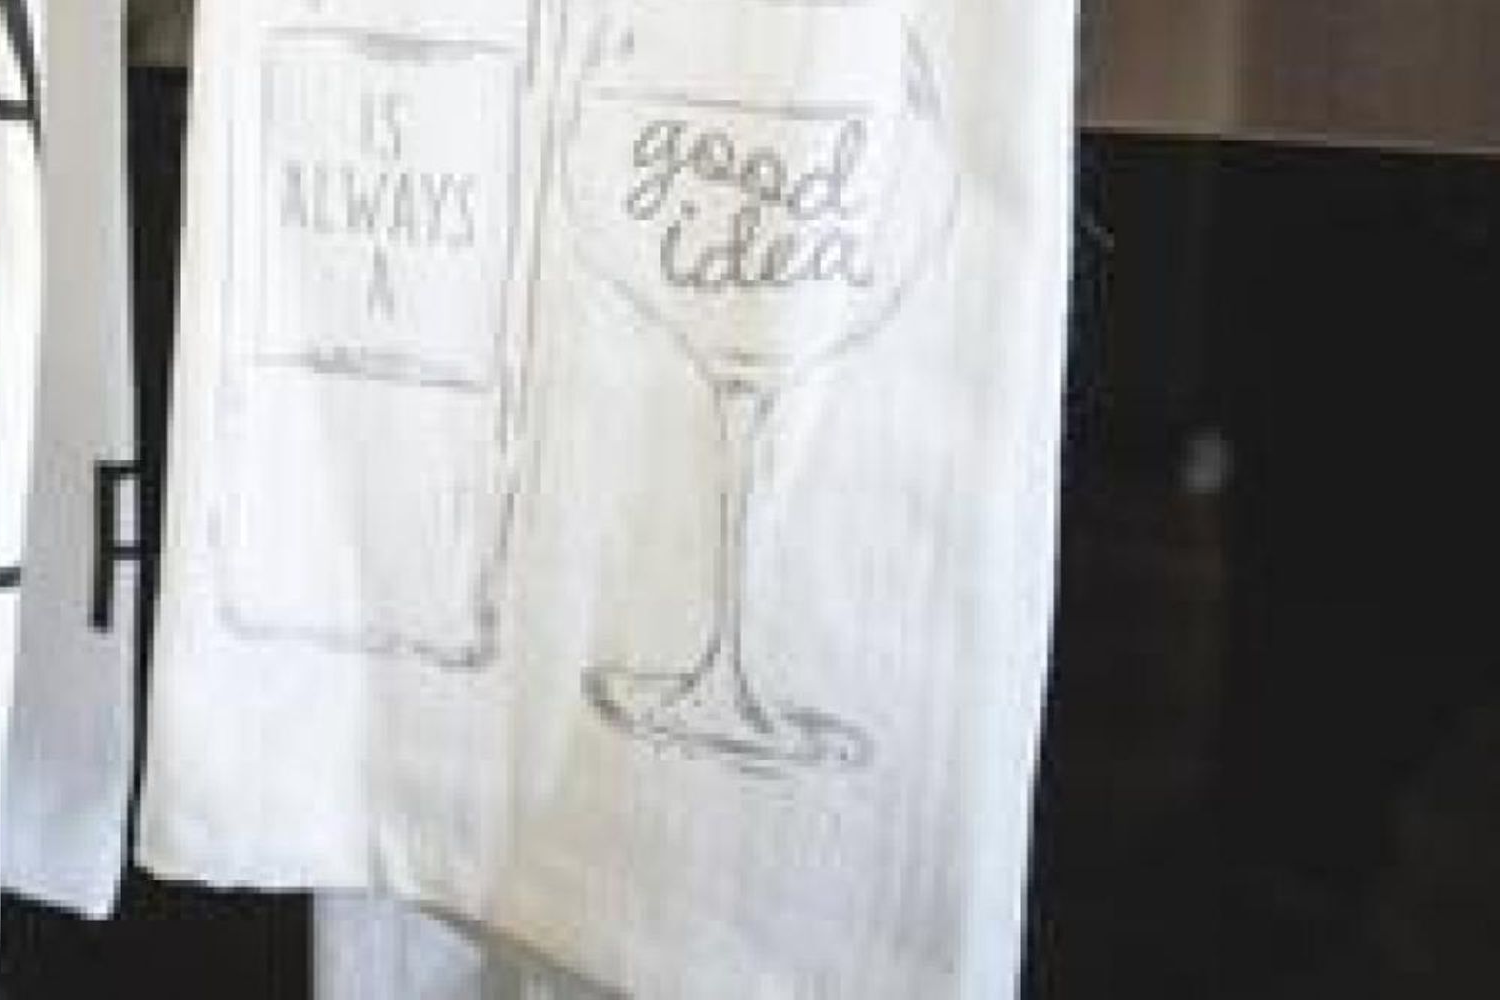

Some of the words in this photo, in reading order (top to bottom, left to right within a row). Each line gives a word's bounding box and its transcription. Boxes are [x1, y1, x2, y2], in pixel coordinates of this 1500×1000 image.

[279, 160, 475, 250] ALWAYS
[622, 117, 866, 220] good
[366, 246, 395, 319] A
[659, 198, 874, 288] idea
